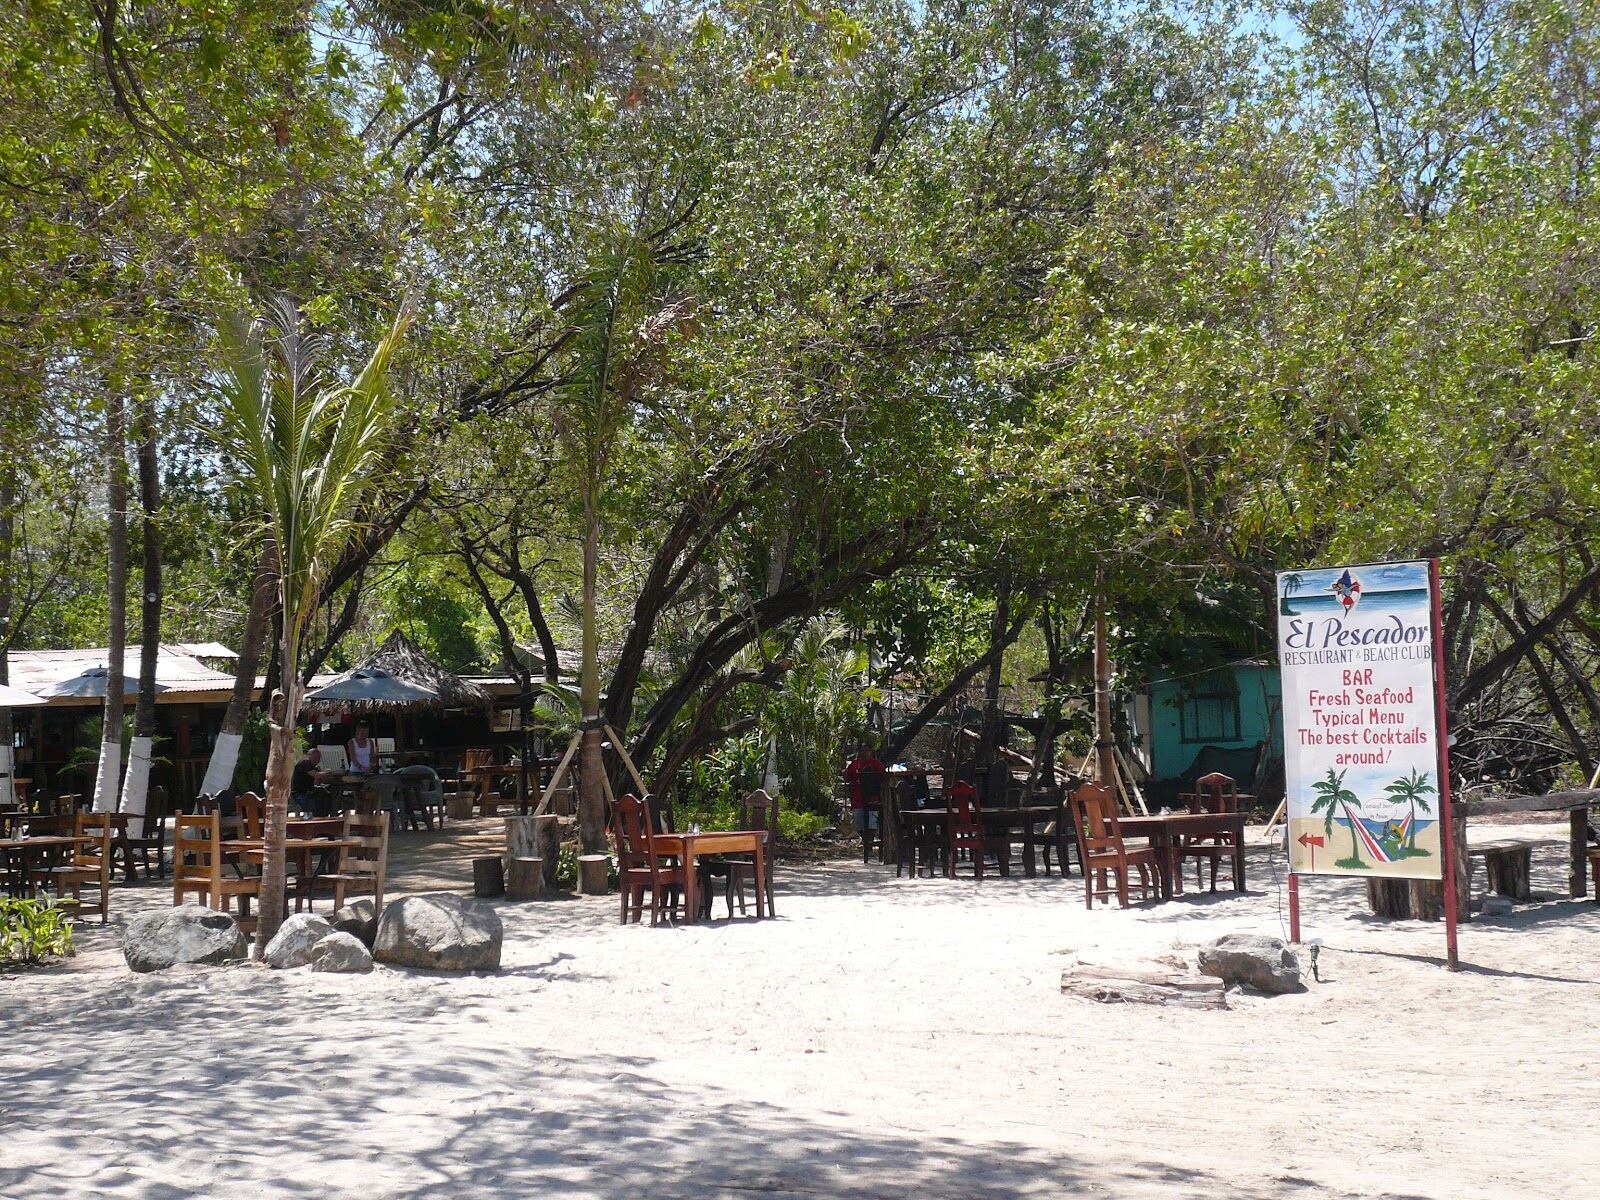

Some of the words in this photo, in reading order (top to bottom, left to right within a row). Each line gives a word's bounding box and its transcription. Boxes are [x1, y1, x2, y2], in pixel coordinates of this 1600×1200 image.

[1285, 619, 1314, 648] El
[1321, 615, 1428, 648] Pescador
[1285, 649, 1353, 665] RESTAURANT
[1364, 647, 1398, 661] BEACH
[1400, 645, 1430, 660] CLUB
[1343, 669, 1373, 685] BAR
[1310, 690, 1350, 706] Fresh
[1355, 687, 1413, 704] Seafood
[1313, 709, 1363, 727] Typical
[1370, 708, 1404, 724] Menu
[1298, 729, 1322, 744] The
[1327, 729, 1358, 744] best
[1364, 727, 1427, 744] Cocktails
[1336, 748, 1392, 764] around!
